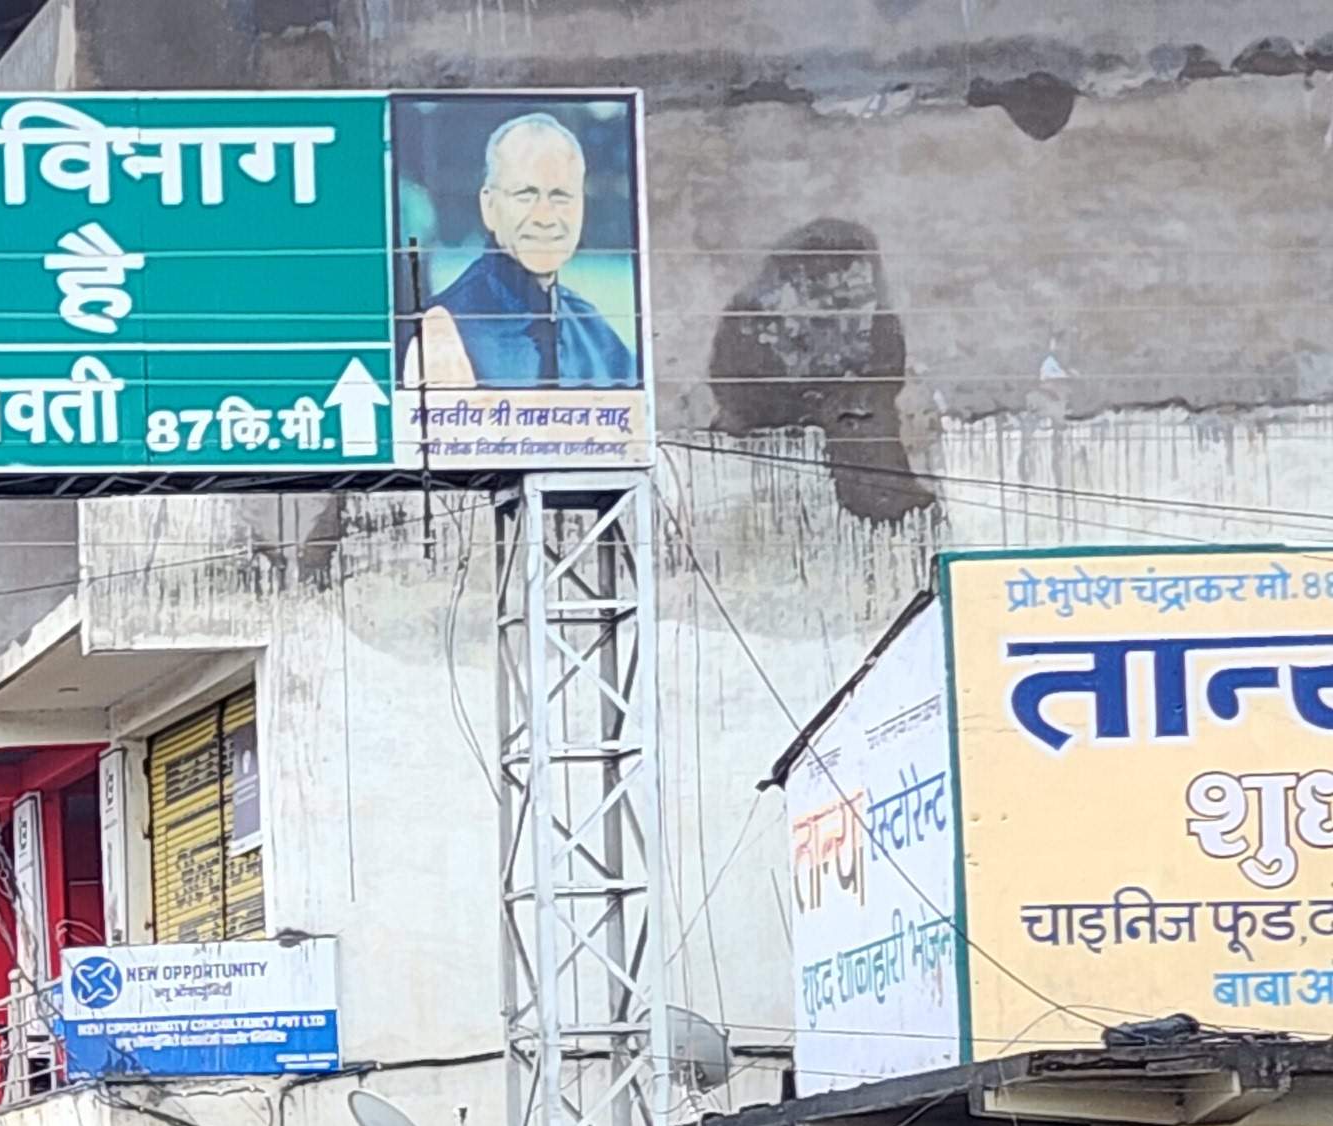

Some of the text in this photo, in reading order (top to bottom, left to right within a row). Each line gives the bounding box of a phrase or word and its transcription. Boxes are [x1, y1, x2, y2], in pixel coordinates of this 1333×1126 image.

[44, 221, 145, 334] है
[488, 399, 511, 427] श्री
[595, 406, 632, 433] साहू
[1020, 886, 1203, 954] चाइनिज
[126, 961, 269, 983] NEW OPPORTUNITY
[1213, 970, 1296, 1008] बाबा
